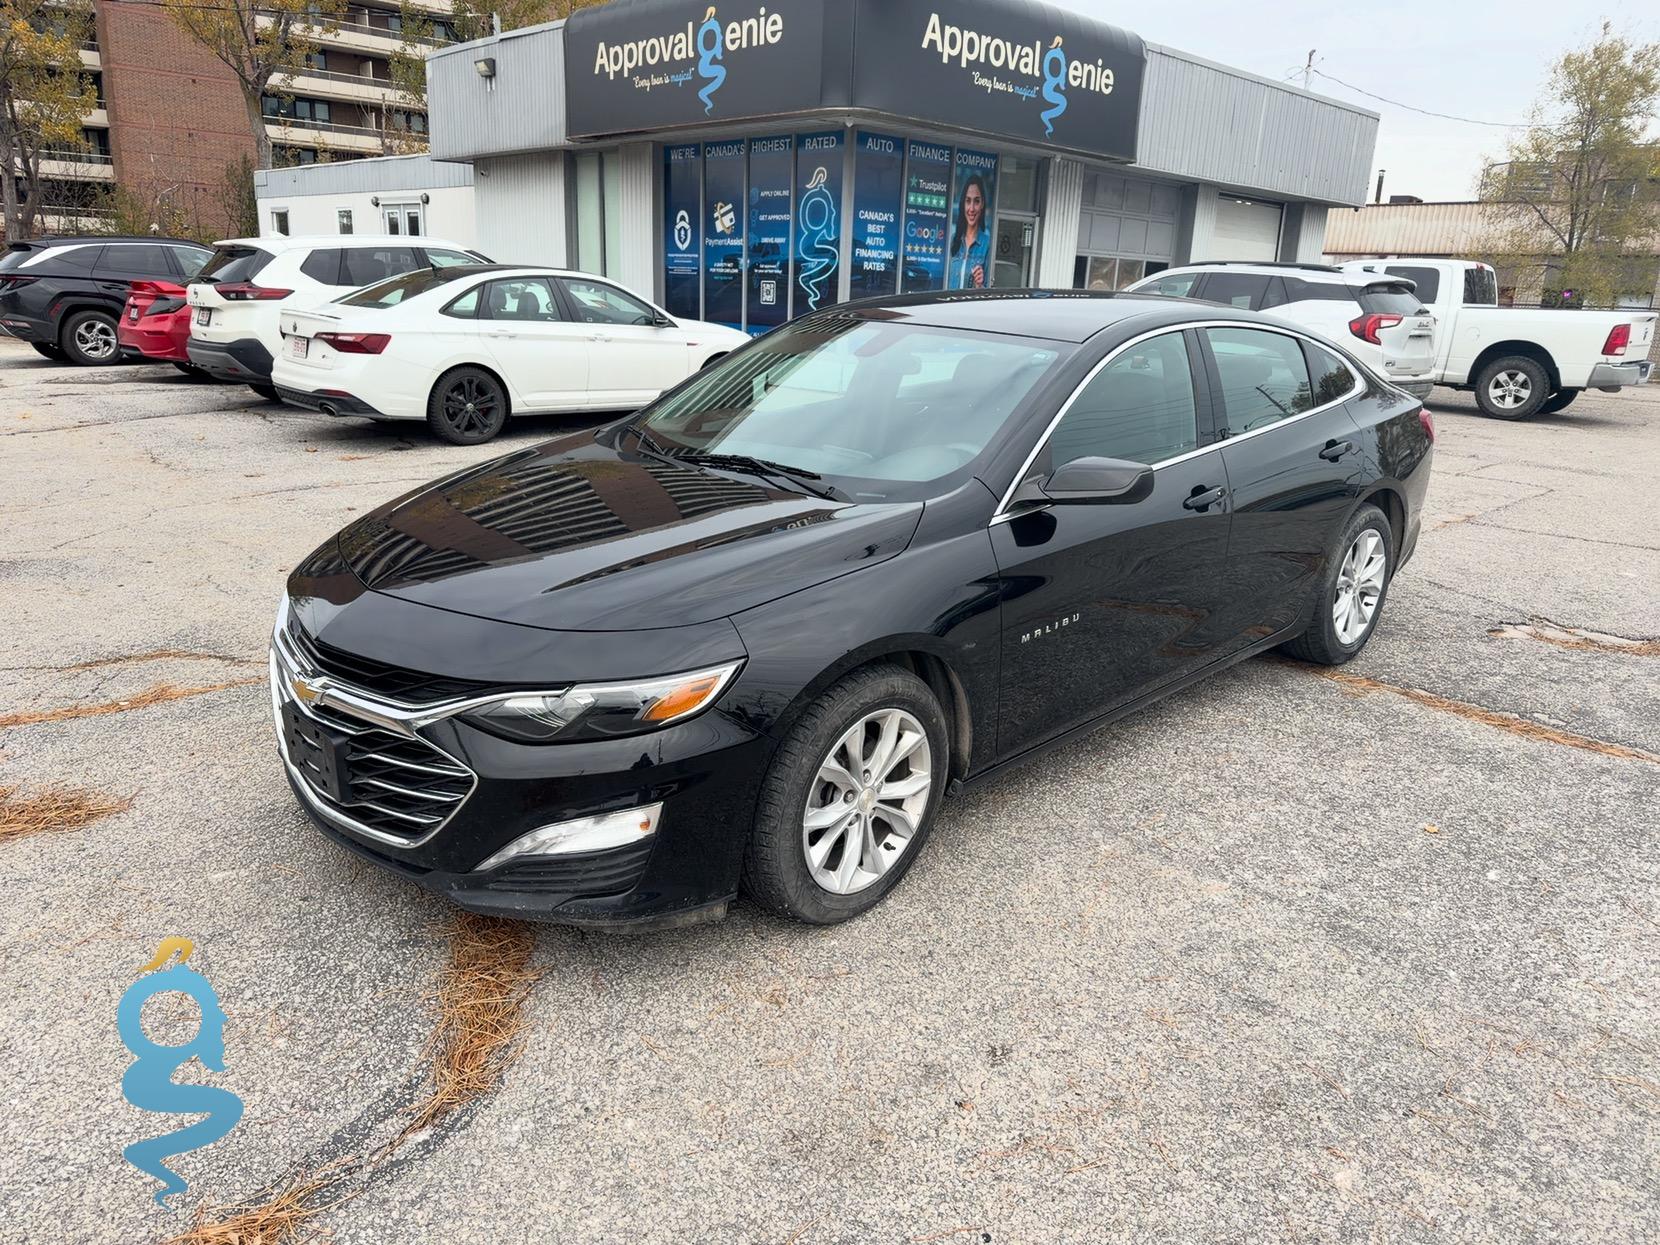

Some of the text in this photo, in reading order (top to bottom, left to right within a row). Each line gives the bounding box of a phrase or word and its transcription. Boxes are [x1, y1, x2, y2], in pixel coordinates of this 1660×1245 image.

[671, 136, 837, 160] WE'RE CANADA'S HIGHEST RATED
[866, 137, 996, 169] AUTO FINANCE COMPANY
[919, 179, 947, 192] Trustpilot
[859, 210, 894, 222] CANADA'S
[867, 223, 885, 234] BEST
[906, 221, 944, 243] Google
[865, 236, 886, 247] AUTO
[855, 248, 894, 260] FINANCING
[863, 261, 885, 272] RATES
[1021, 613, 1080, 644] MALIBU
